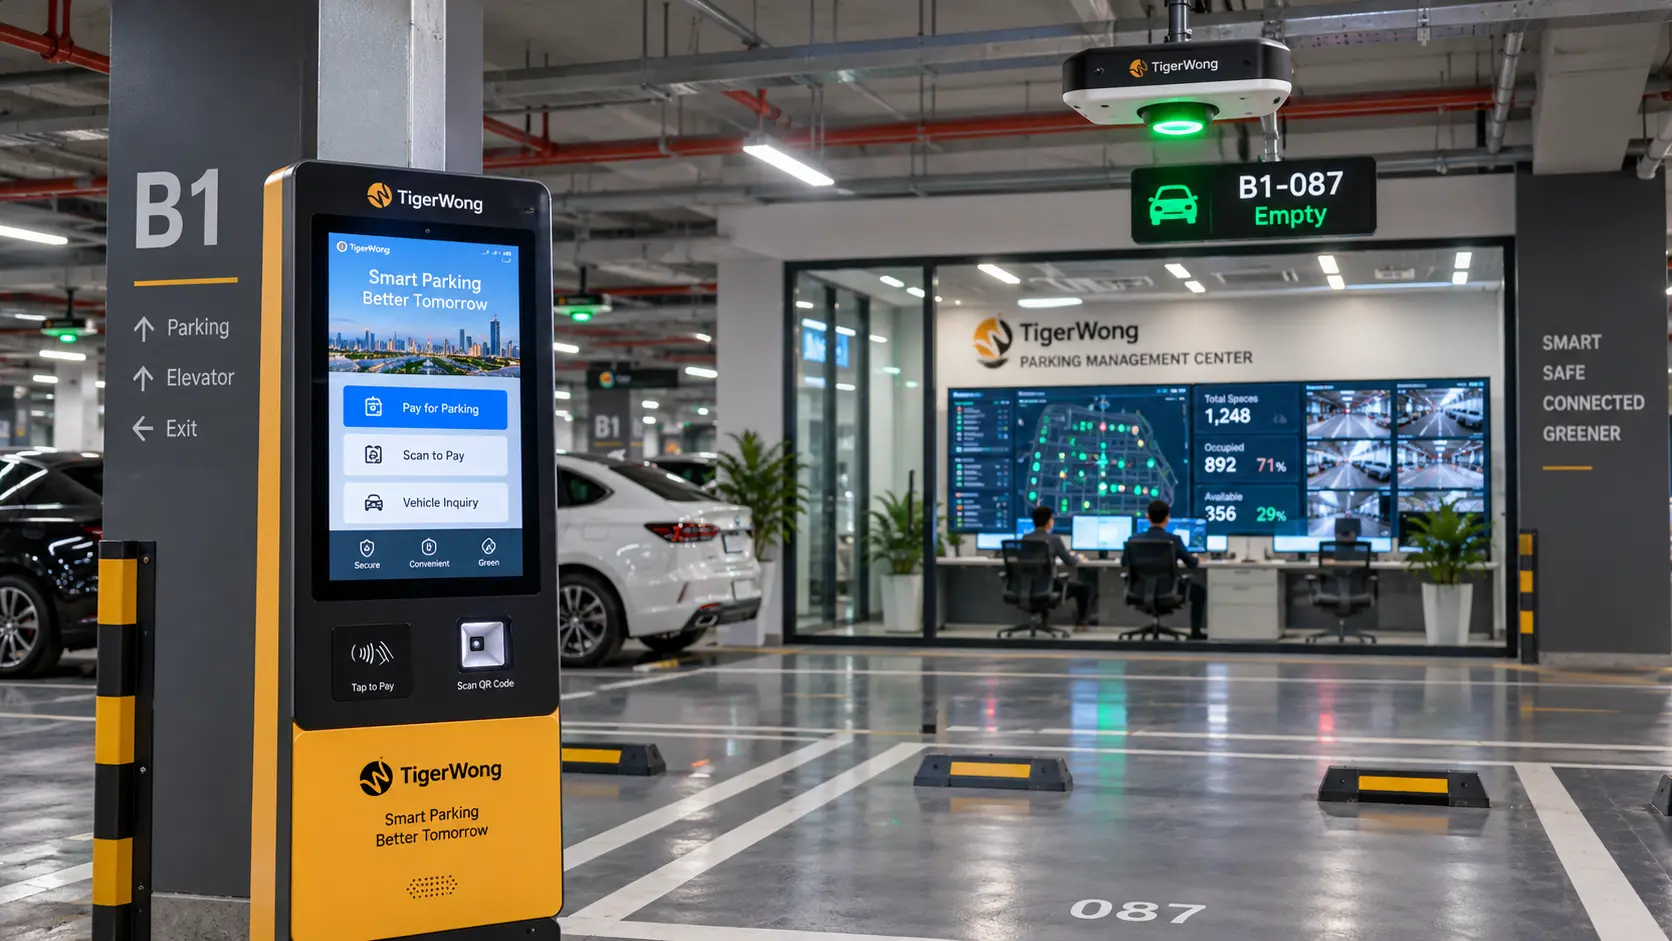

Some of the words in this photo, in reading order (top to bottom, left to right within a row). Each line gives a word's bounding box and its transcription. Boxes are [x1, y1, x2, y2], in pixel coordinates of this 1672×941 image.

[1151, 59, 1219, 75] TigerWong
[1239, 171, 1344, 199] B1-087
[135, 168, 219, 249] B1
[397, 189, 484, 214] TigerWong
[1254, 205, 1328, 229] Empty
[369, 269, 418, 287] Smart
[422, 272, 482, 294] Parking
[363, 291, 410, 307] Better
[413, 293, 488, 311] Tomorrow
[167, 317, 230, 339] Parking
[1020, 321, 1139, 347] TigerWong
[1542, 334, 1602, 350] SMART
[1020, 354, 1082, 368] PARKING
[1086, 352, 1190, 367] MANAGEMENT
[1194, 351, 1254, 365] CENTER
[167, 368, 235, 387] Elevator
[1542, 364, 1586, 381] SAFE
[1204, 394, 1226, 404] Total
[1227, 394, 1259, 405] Spaces
[1542, 394, 1646, 411] CONNECTED
[403, 402, 422, 415] Pay
[424, 403, 439, 414] for
[441, 403, 479, 417] Parking
[1204, 407, 1251, 427] 1,248
[166, 419, 198, 437] Exit
[594, 415, 620, 439] B1
[1542, 425, 1622, 442] GREENER
[403, 450, 430, 461] Scan
[432, 450, 443, 460] to
[446, 450, 465, 463] Pay
[1204, 443, 1245, 454] Occupied
[1204, 456, 1237, 473] 892
[1256, 457, 1287, 473] 71%
[403, 497, 441, 508] Vehicle
[443, 497, 479, 510] Inquiry
[1204, 492, 1243, 502] Available
[1204, 505, 1237, 522] 356
[1256, 506, 1287, 522] 29%
[354, 561, 381, 570] Secure
[409, 560, 450, 569] Convenient
[478, 558, 500, 567] Green
[351, 682, 366, 693] Tap
[368, 683, 378, 691] to
[379, 681, 395, 692] Pay
[457, 681, 477, 690] Scan
[478, 680, 492, 690] QR
[493, 679, 515, 689] Code
[400, 762, 502, 787] TigerWong
[385, 810, 426, 826] Smart
[430, 806, 480, 823] Parking
[376, 830, 419, 847] Better
[422, 825, 489, 842] Tomorrow
[1069, 898, 1207, 924] 087
